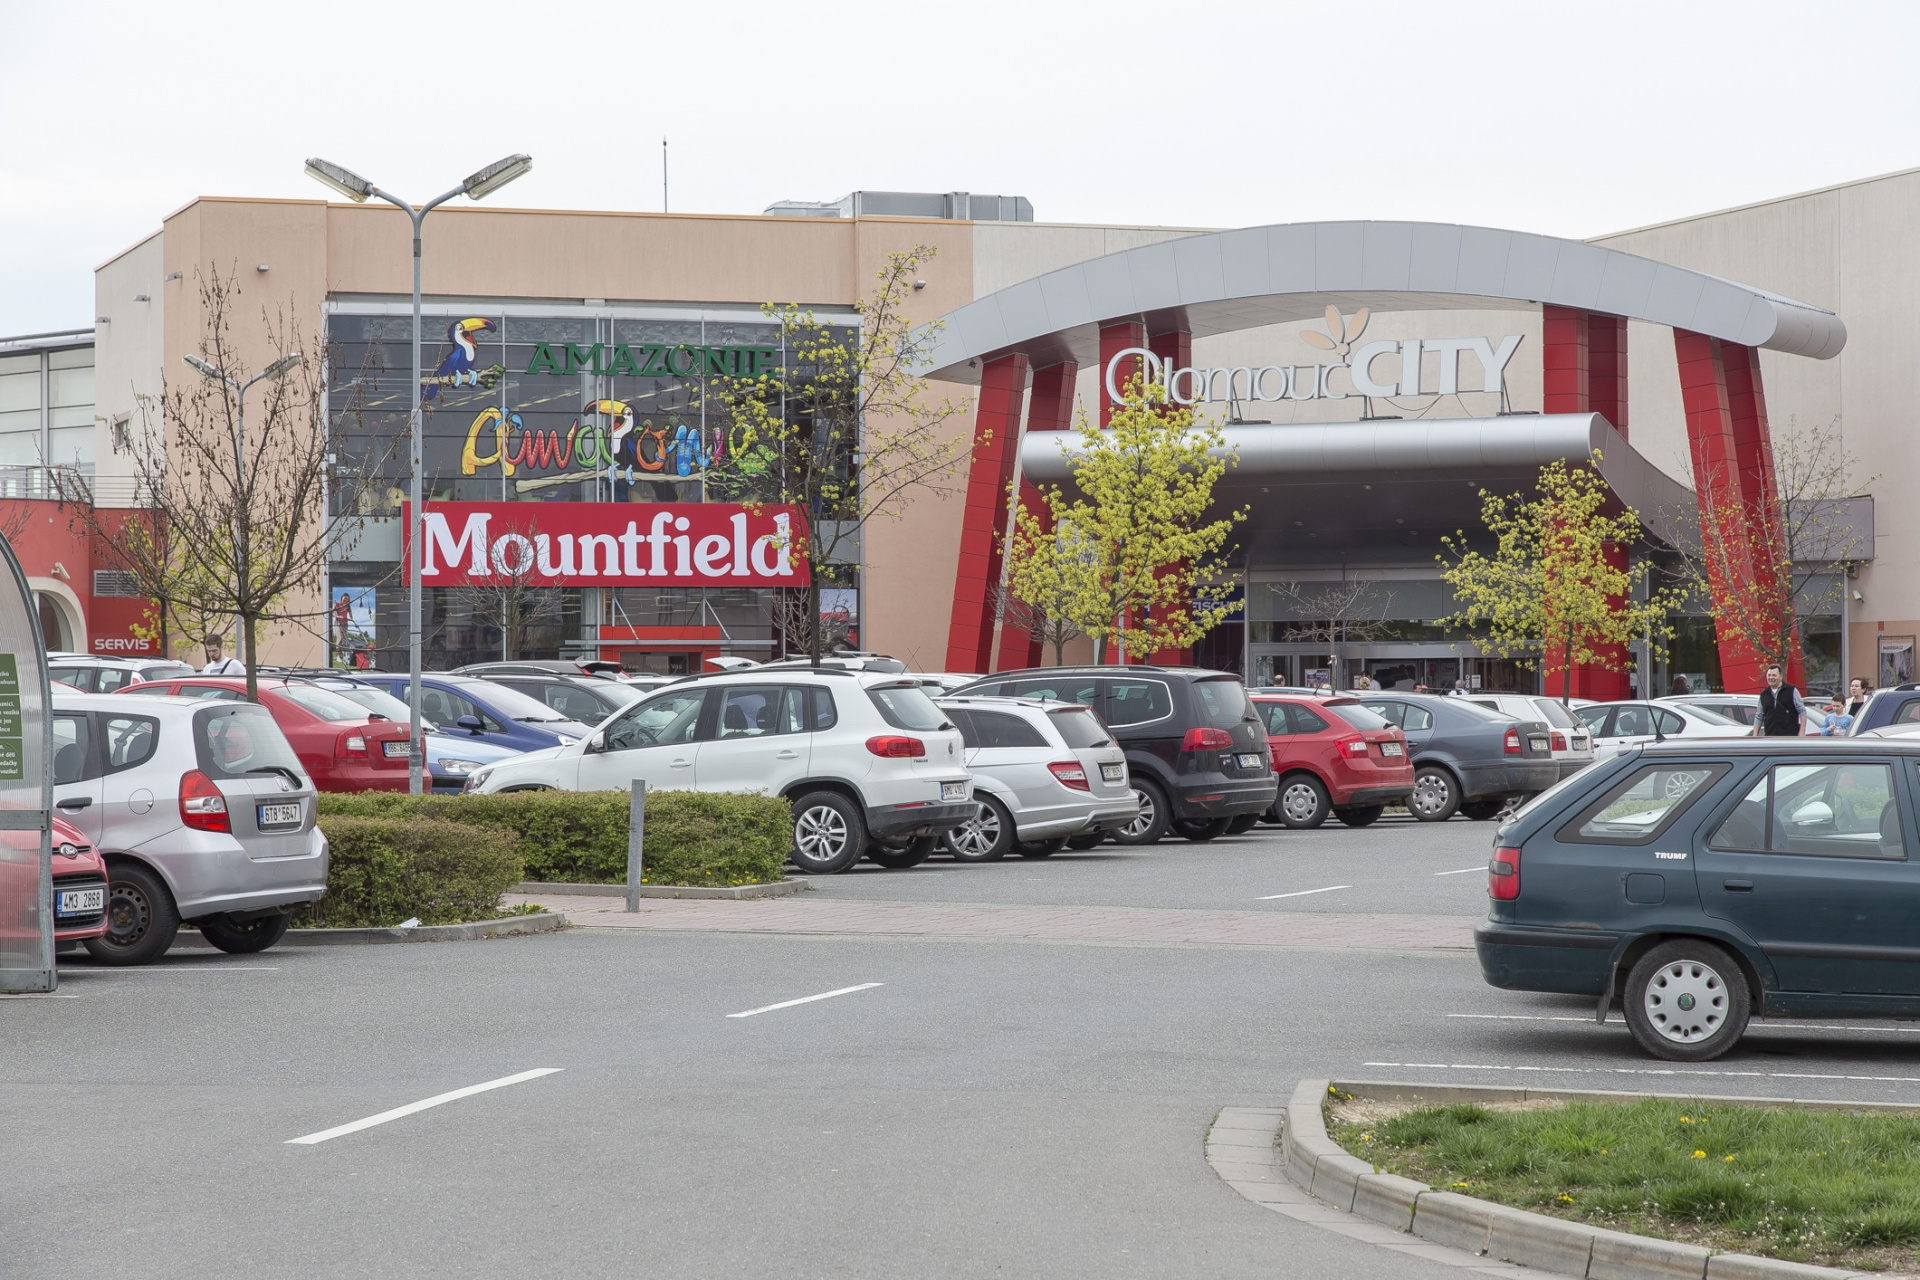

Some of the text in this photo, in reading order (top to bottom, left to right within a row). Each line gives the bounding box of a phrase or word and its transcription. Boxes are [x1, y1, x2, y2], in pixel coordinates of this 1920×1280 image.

[526, 341, 778, 379] AMAZONIE
[1105, 334, 1525, 405] Olomouc CITY
[420, 511, 794, 577] Mountfield
[94, 638, 150, 650] SERVIS
[265, 805, 298, 822] 6T8 5647
[1654, 852, 1687, 860] TRUMF
[63, 891, 101, 910] 4M3 2868
